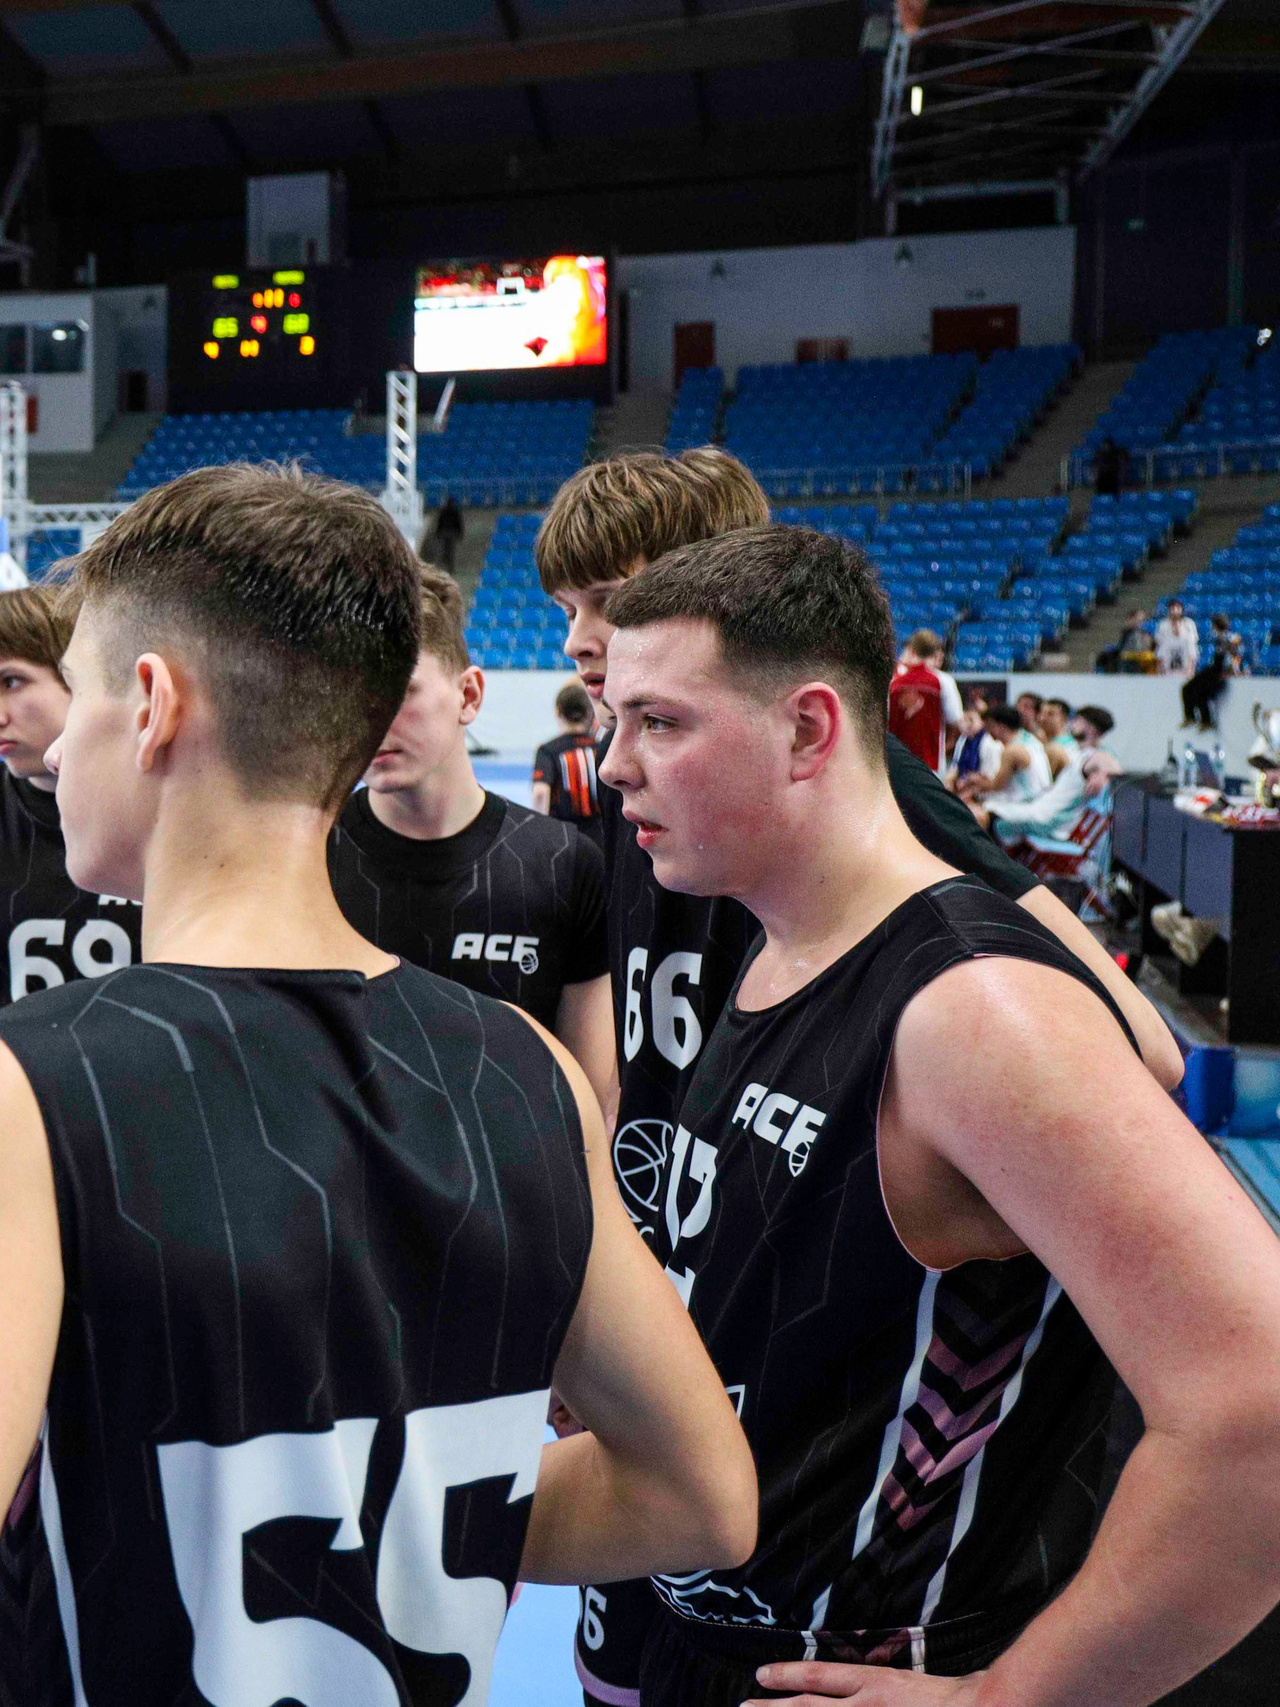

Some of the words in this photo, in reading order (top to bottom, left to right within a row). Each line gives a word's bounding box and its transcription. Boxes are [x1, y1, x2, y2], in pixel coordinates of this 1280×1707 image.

[8, 918, 132, 1004] 69
[451, 932, 540, 975] АСБ
[624, 946, 704, 1071] 66
[156, 1386, 551, 1707] 55
